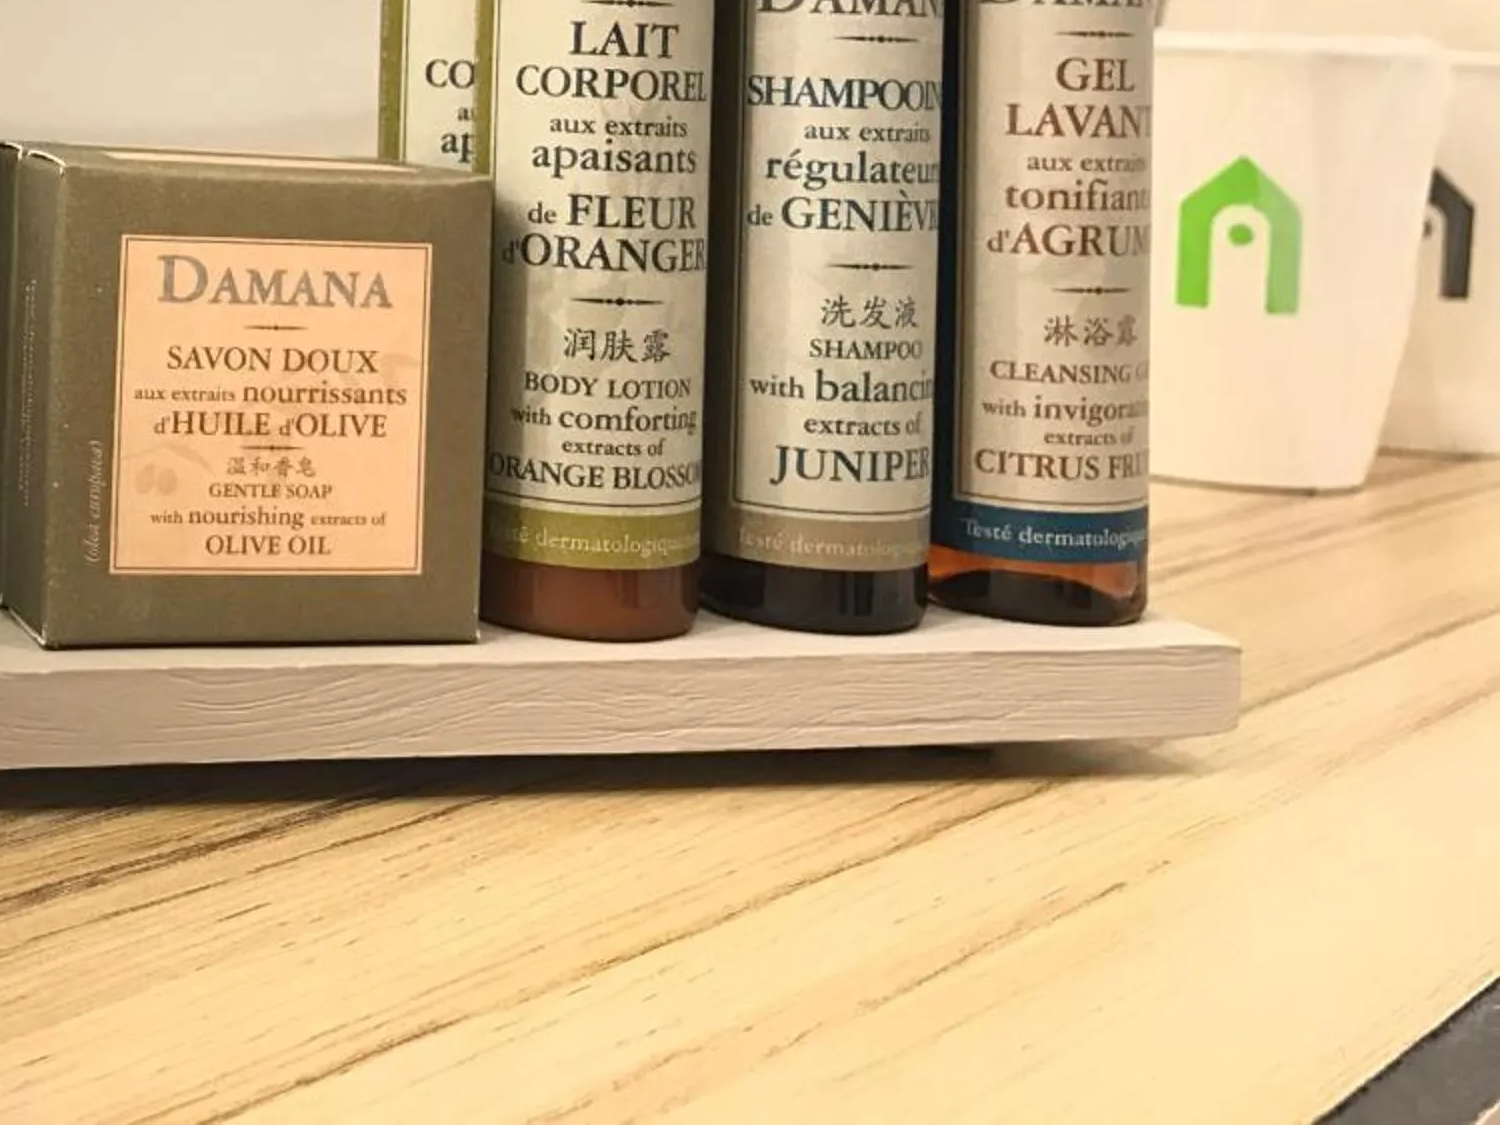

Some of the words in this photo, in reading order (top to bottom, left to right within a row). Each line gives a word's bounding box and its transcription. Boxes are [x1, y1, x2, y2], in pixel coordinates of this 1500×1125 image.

[568, 20, 680, 59] LAIT
[515, 64, 708, 103] CORPOREL
[1055, 56, 1136, 92] GEL
[549, 118, 596, 135] aux
[604, 115, 688, 138] extraits
[803, 124, 850, 140] aux
[858, 122, 931, 143] extraits
[531, 137, 697, 179] apaisants
[1026, 155, 1073, 172] aux
[527, 201, 558, 225] de
[566, 193, 697, 231] FLEUR
[747, 204, 773, 226] de
[502, 233, 707, 273] d'ORANGER
[157, 254, 394, 310] DAMANA
[820, 295, 918, 330] 洗发液
[1044, 314, 1138, 348] 淋浴露
[166, 344, 272, 373] SAVON
[282, 347, 379, 375] DOUX
[562, 328, 672, 364] 润肤露
[808, 338, 923, 361] SHAMPOO
[524, 371, 599, 398] BODY
[606, 378, 692, 401] LOTION
[989, 359, 1131, 385] CLEANSING
[133, 387, 167, 401] aux
[171, 385, 236, 402] extraits
[241, 380, 408, 406] nourrissants
[749, 374, 805, 400] with
[511, 406, 552, 427] with
[558, 406, 698, 436] comforting
[981, 398, 1027, 418] with
[153, 411, 270, 437] d'HUILE
[278, 412, 387, 439] d'OLIVE
[803, 418, 901, 437] extracts
[905, 410, 922, 436] of
[561, 440, 642, 457] extracts
[647, 438, 664, 456] of
[1043, 431, 1117, 446] extracts
[226, 456, 318, 478] 温和香皂
[488, 451, 605, 489] ORANGE
[769, 444, 930, 486] JUNIPER
[974, 448, 1100, 481] CITRUS
[207, 482, 282, 500] GENTLE
[285, 482, 333, 501] SOAP
[149, 510, 183, 525] with
[187, 505, 305, 530] nourishing
[310, 511, 367, 526] extracts
[370, 510, 387, 526] of
[204, 534, 283, 556] OLIVE
[287, 534, 332, 556] OIL
